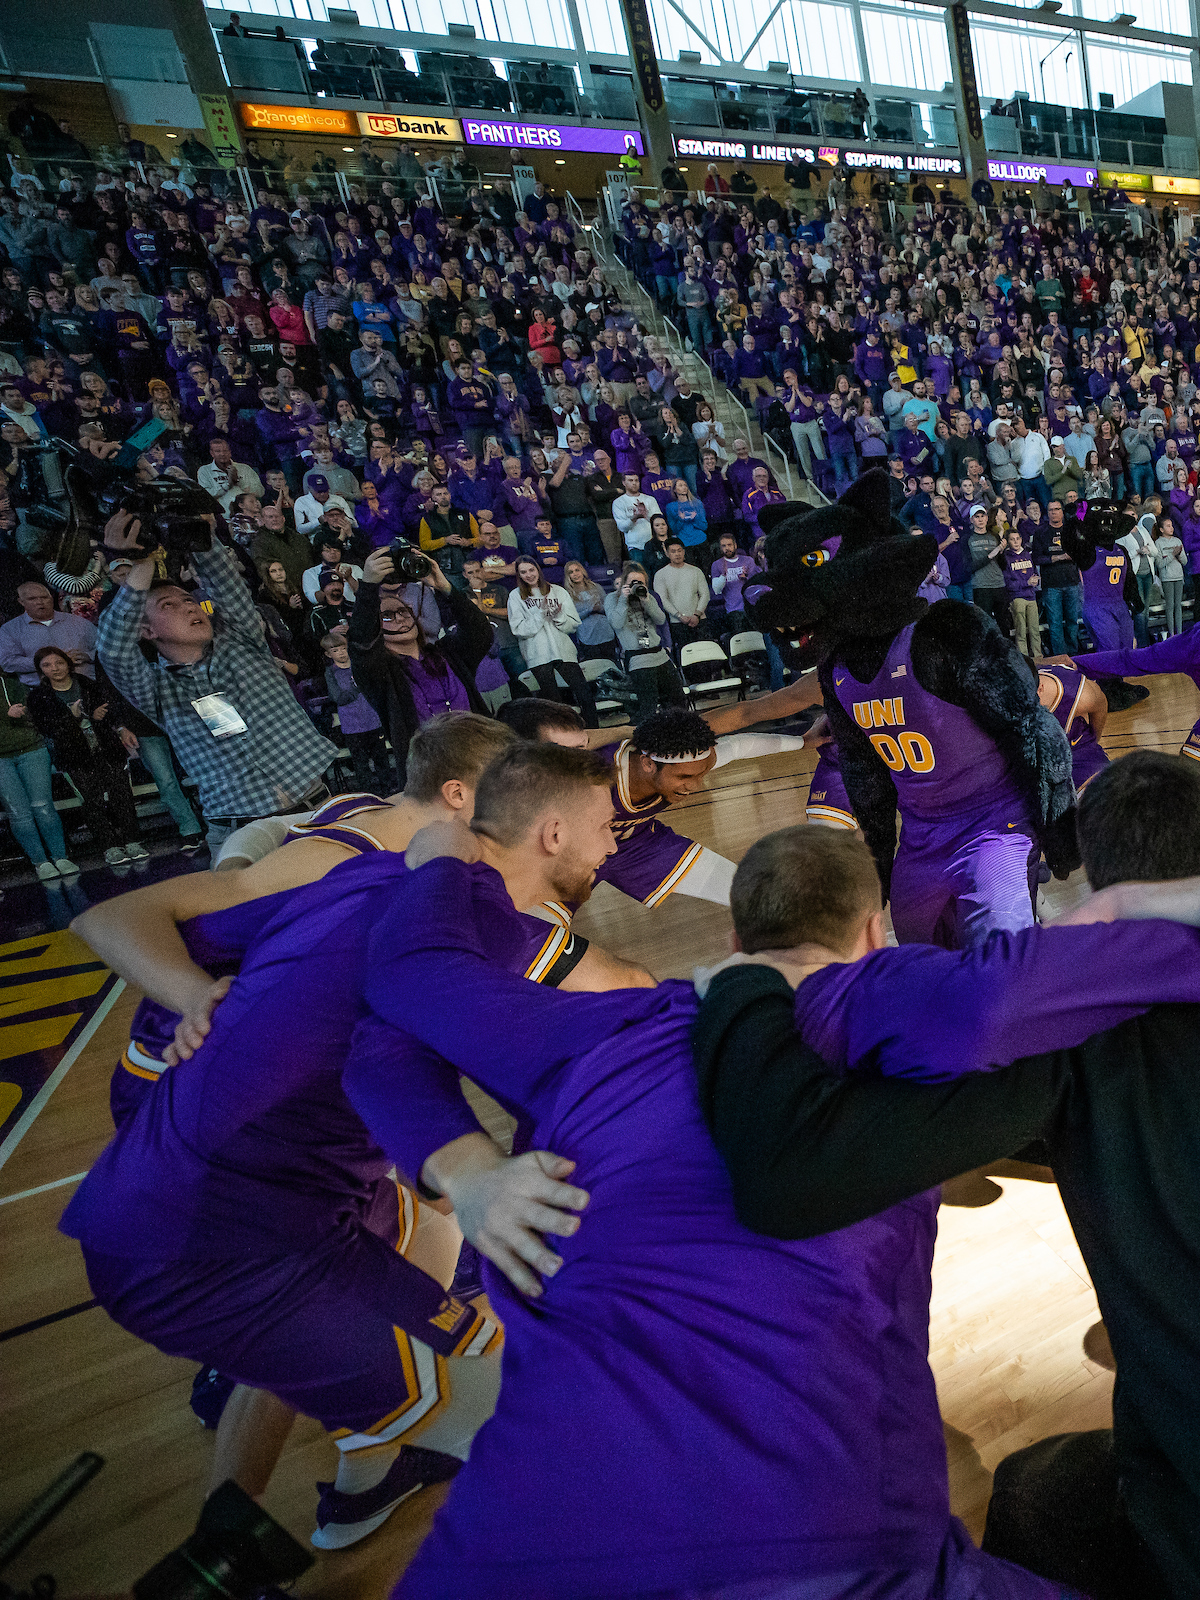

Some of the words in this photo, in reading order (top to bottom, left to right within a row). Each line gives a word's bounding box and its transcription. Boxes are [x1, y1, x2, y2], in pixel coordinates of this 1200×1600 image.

[642, 53, 658, 107] PATIO
[211, 108, 229, 141] MINI
[967, 91, 980, 138] PATIO
[467, 123, 562, 147] PANTHERS
[678, 139, 747, 158] STARTING
[845, 152, 904, 169] STARTING
[907, 156, 962, 174] LINEUPS
[515, 169, 535, 179] 106
[608, 175, 625, 183] 107
[1106, 556, 1125, 566] UNI
[1109, 567, 1121, 585] 0
[853, 697, 905, 729] UNI
[869, 731, 935, 773] 00
